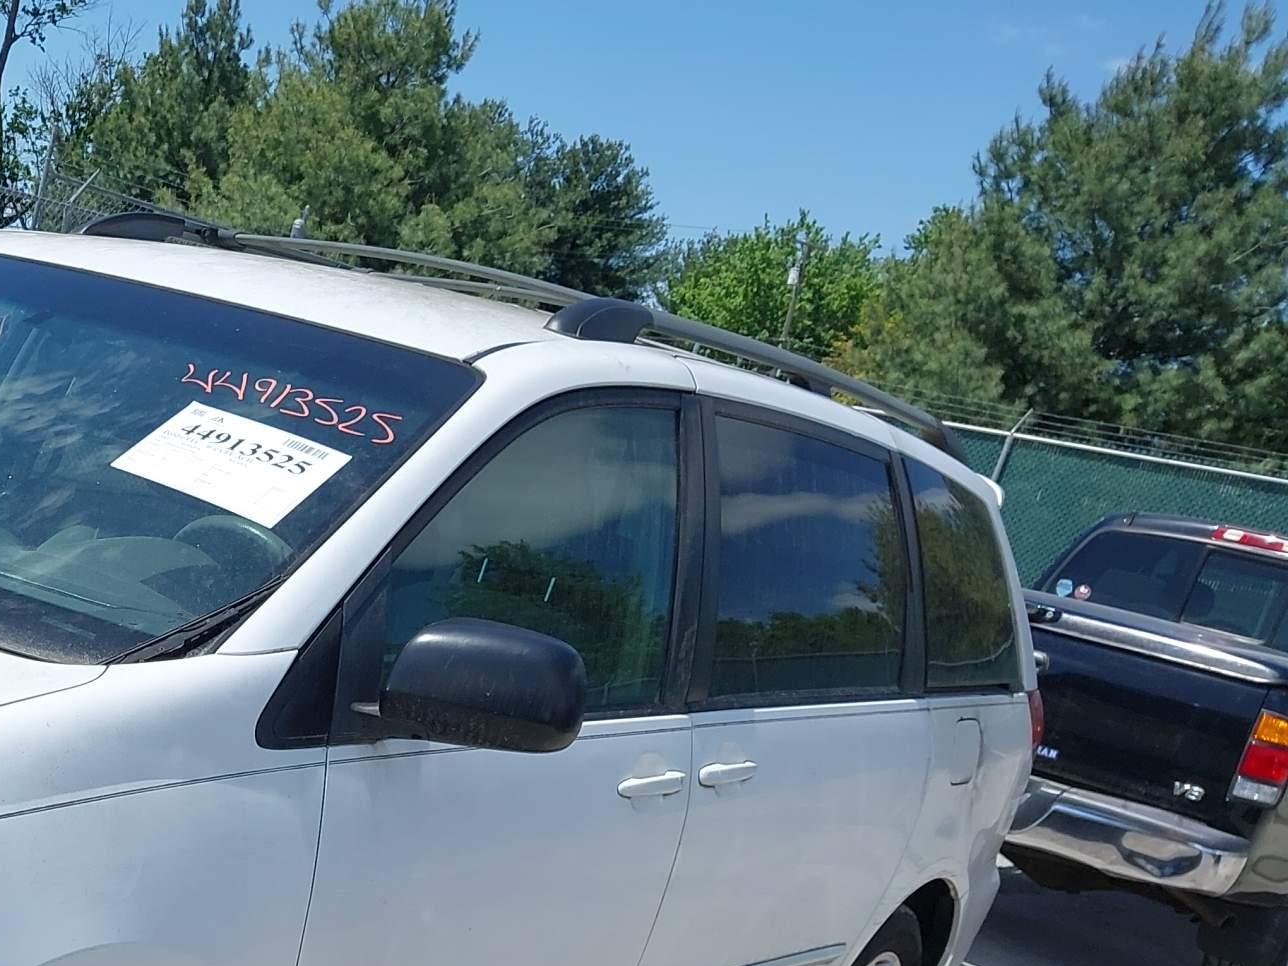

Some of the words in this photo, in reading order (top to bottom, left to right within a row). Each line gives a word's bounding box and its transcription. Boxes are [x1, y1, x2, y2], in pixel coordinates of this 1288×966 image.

[181, 363, 403, 444] 44913525
[181, 423, 313, 475] 44913525
[1173, 781, 1205, 801] V8
